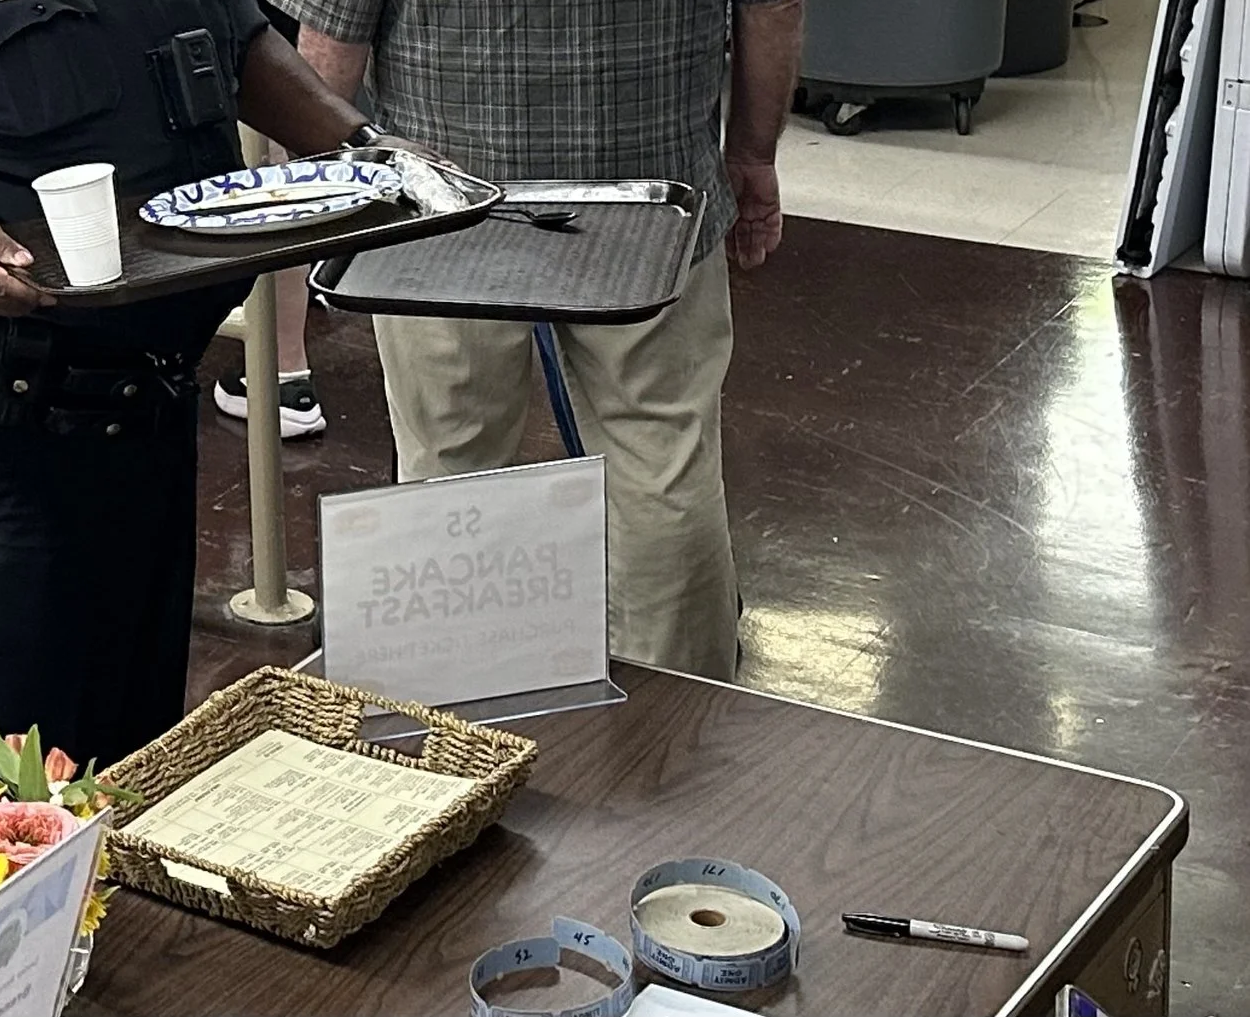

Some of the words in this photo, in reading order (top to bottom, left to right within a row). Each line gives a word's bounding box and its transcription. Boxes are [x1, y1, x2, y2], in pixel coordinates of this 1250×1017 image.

[573, 932, 595, 945] 45
[515, 949, 533, 964] 52
[720, 969, 743, 977] ONE
[714, 975, 748, 984] ADMIT
